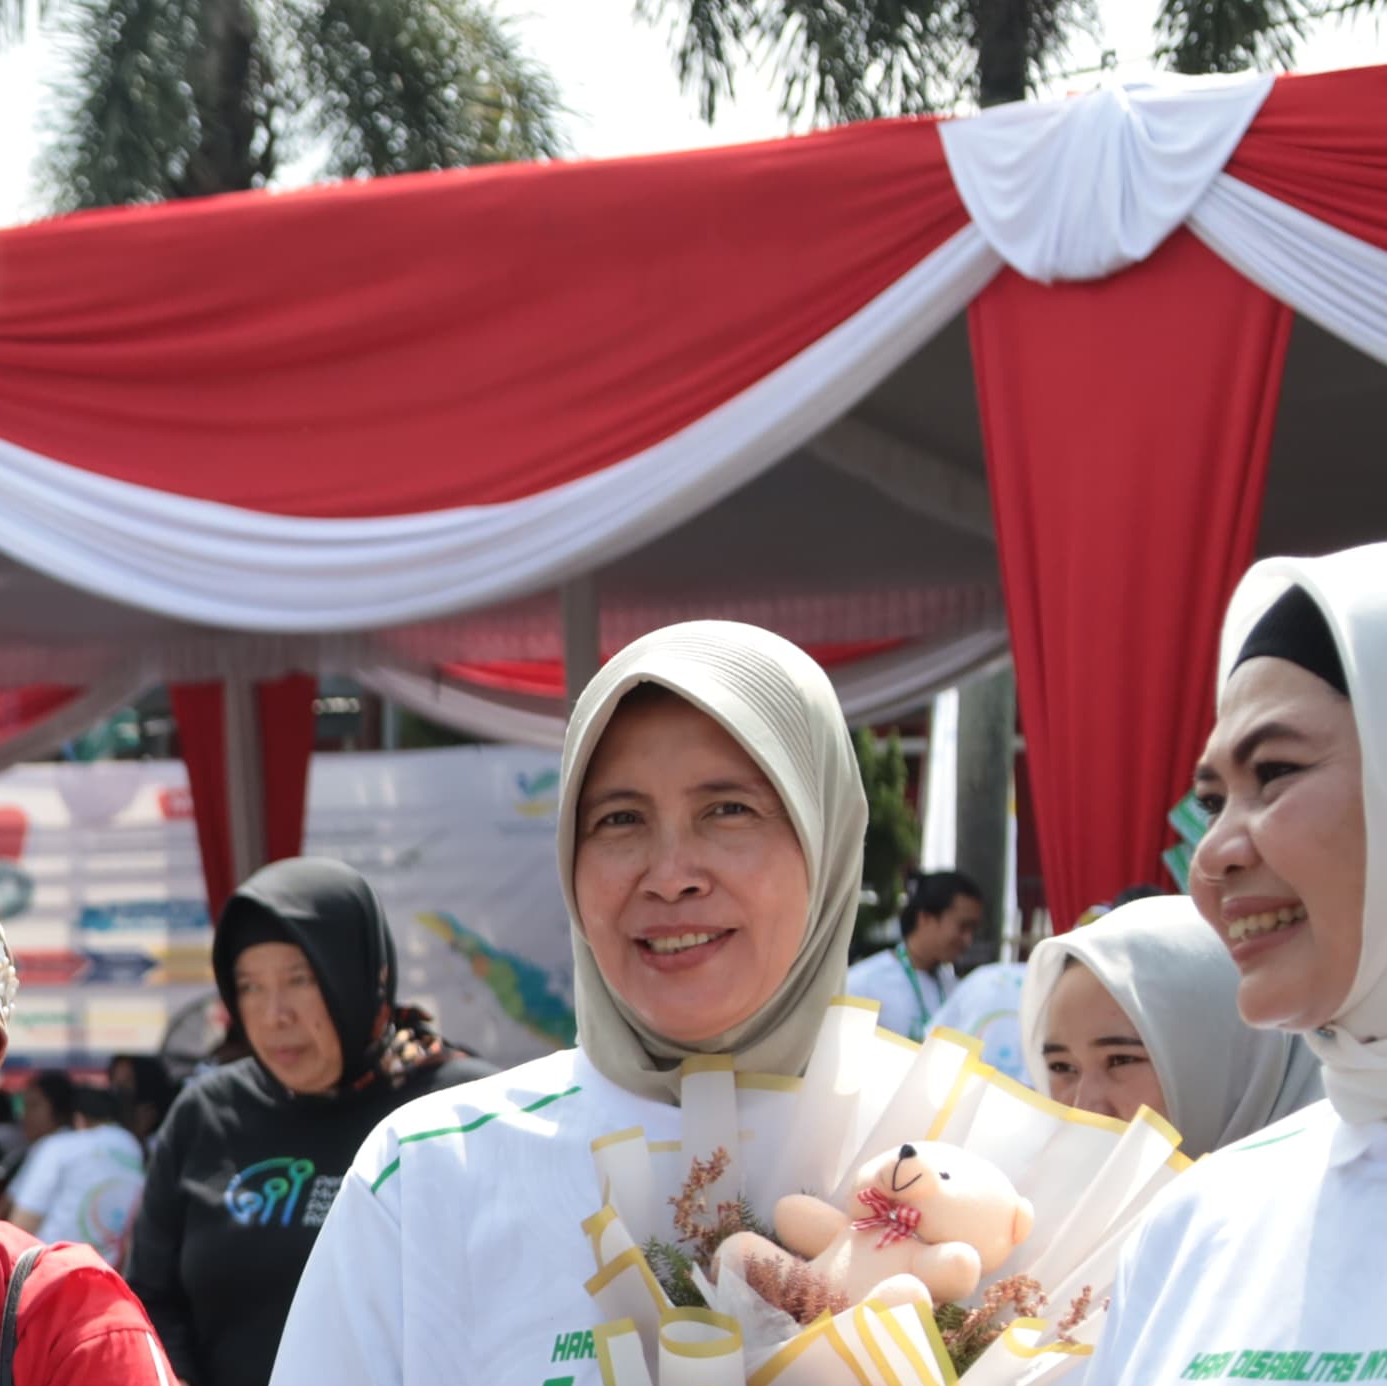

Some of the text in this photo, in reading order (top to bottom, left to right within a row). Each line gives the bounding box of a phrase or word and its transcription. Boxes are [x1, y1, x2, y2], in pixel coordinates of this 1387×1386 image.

[551, 1329, 597, 1363] HAR
[1179, 1351, 1233, 1381] HARI
[1227, 1348, 1363, 1383] DISABILITAS
